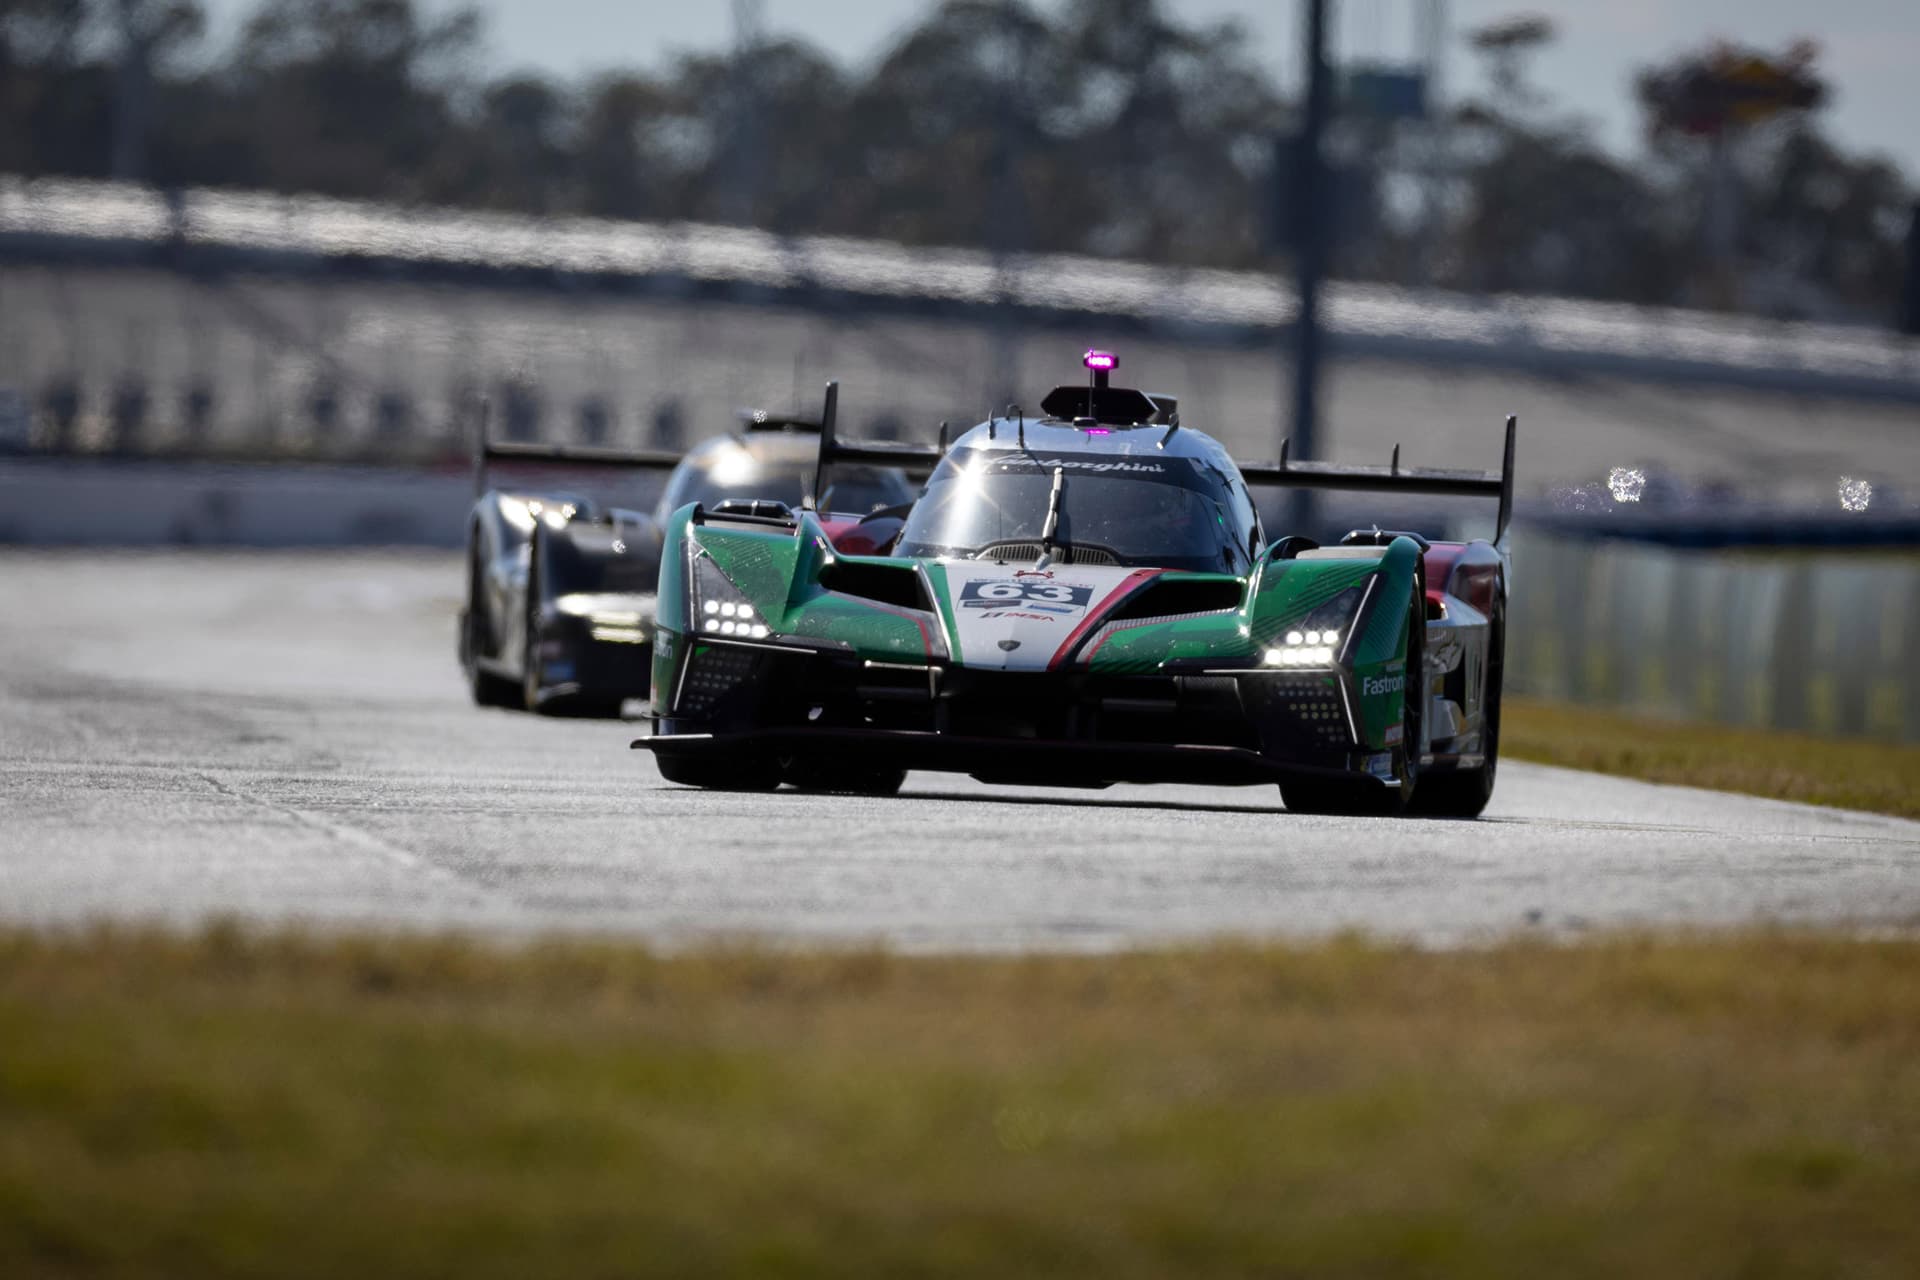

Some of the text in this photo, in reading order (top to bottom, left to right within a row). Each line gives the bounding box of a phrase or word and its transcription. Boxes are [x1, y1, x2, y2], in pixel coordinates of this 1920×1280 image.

[987, 452, 1166, 473] Lamborghini
[977, 582, 1073, 601] 63
[1363, 675, 1404, 696] Fastron
